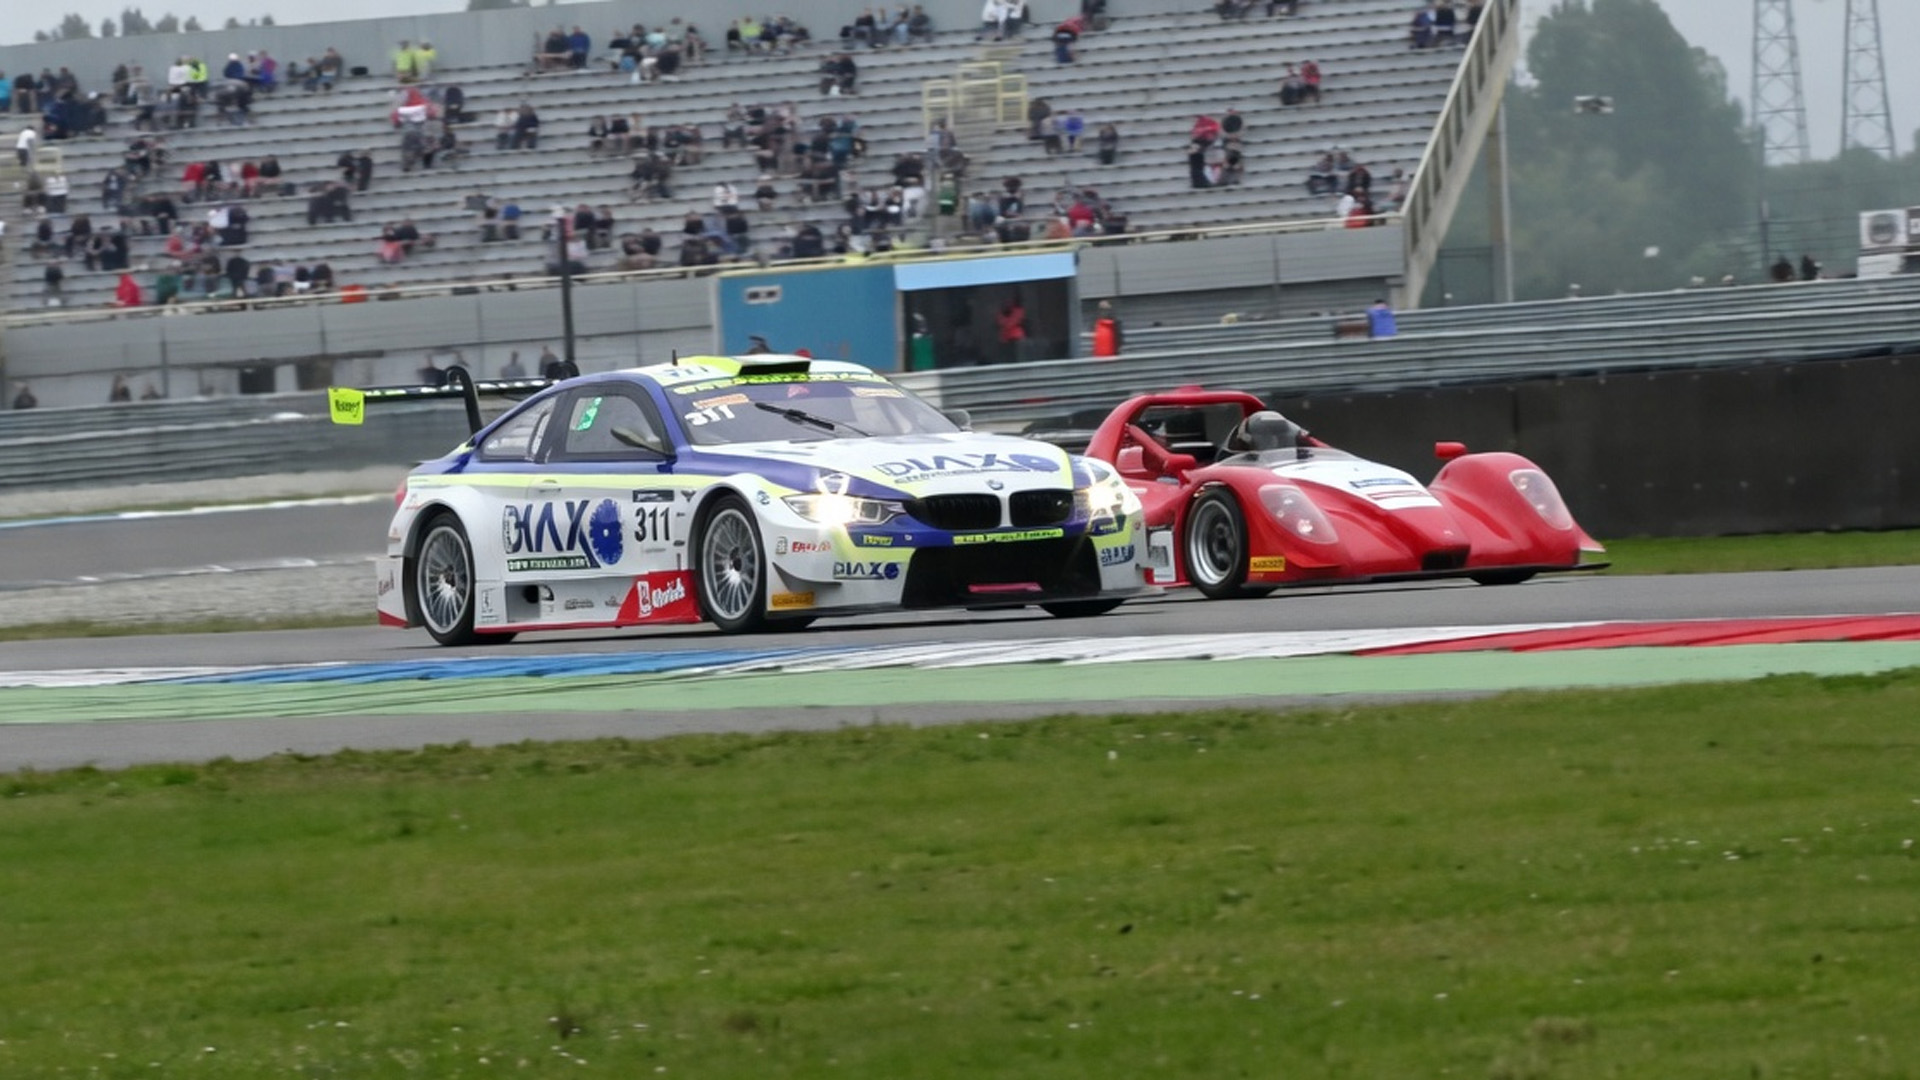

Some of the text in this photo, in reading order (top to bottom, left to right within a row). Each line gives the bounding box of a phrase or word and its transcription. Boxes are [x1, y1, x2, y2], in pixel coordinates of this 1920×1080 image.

[684, 404, 736, 426] 311
[502, 499, 601, 568] DIAX
[634, 507, 671, 542] 311
[833, 562, 885, 579] DIAX
